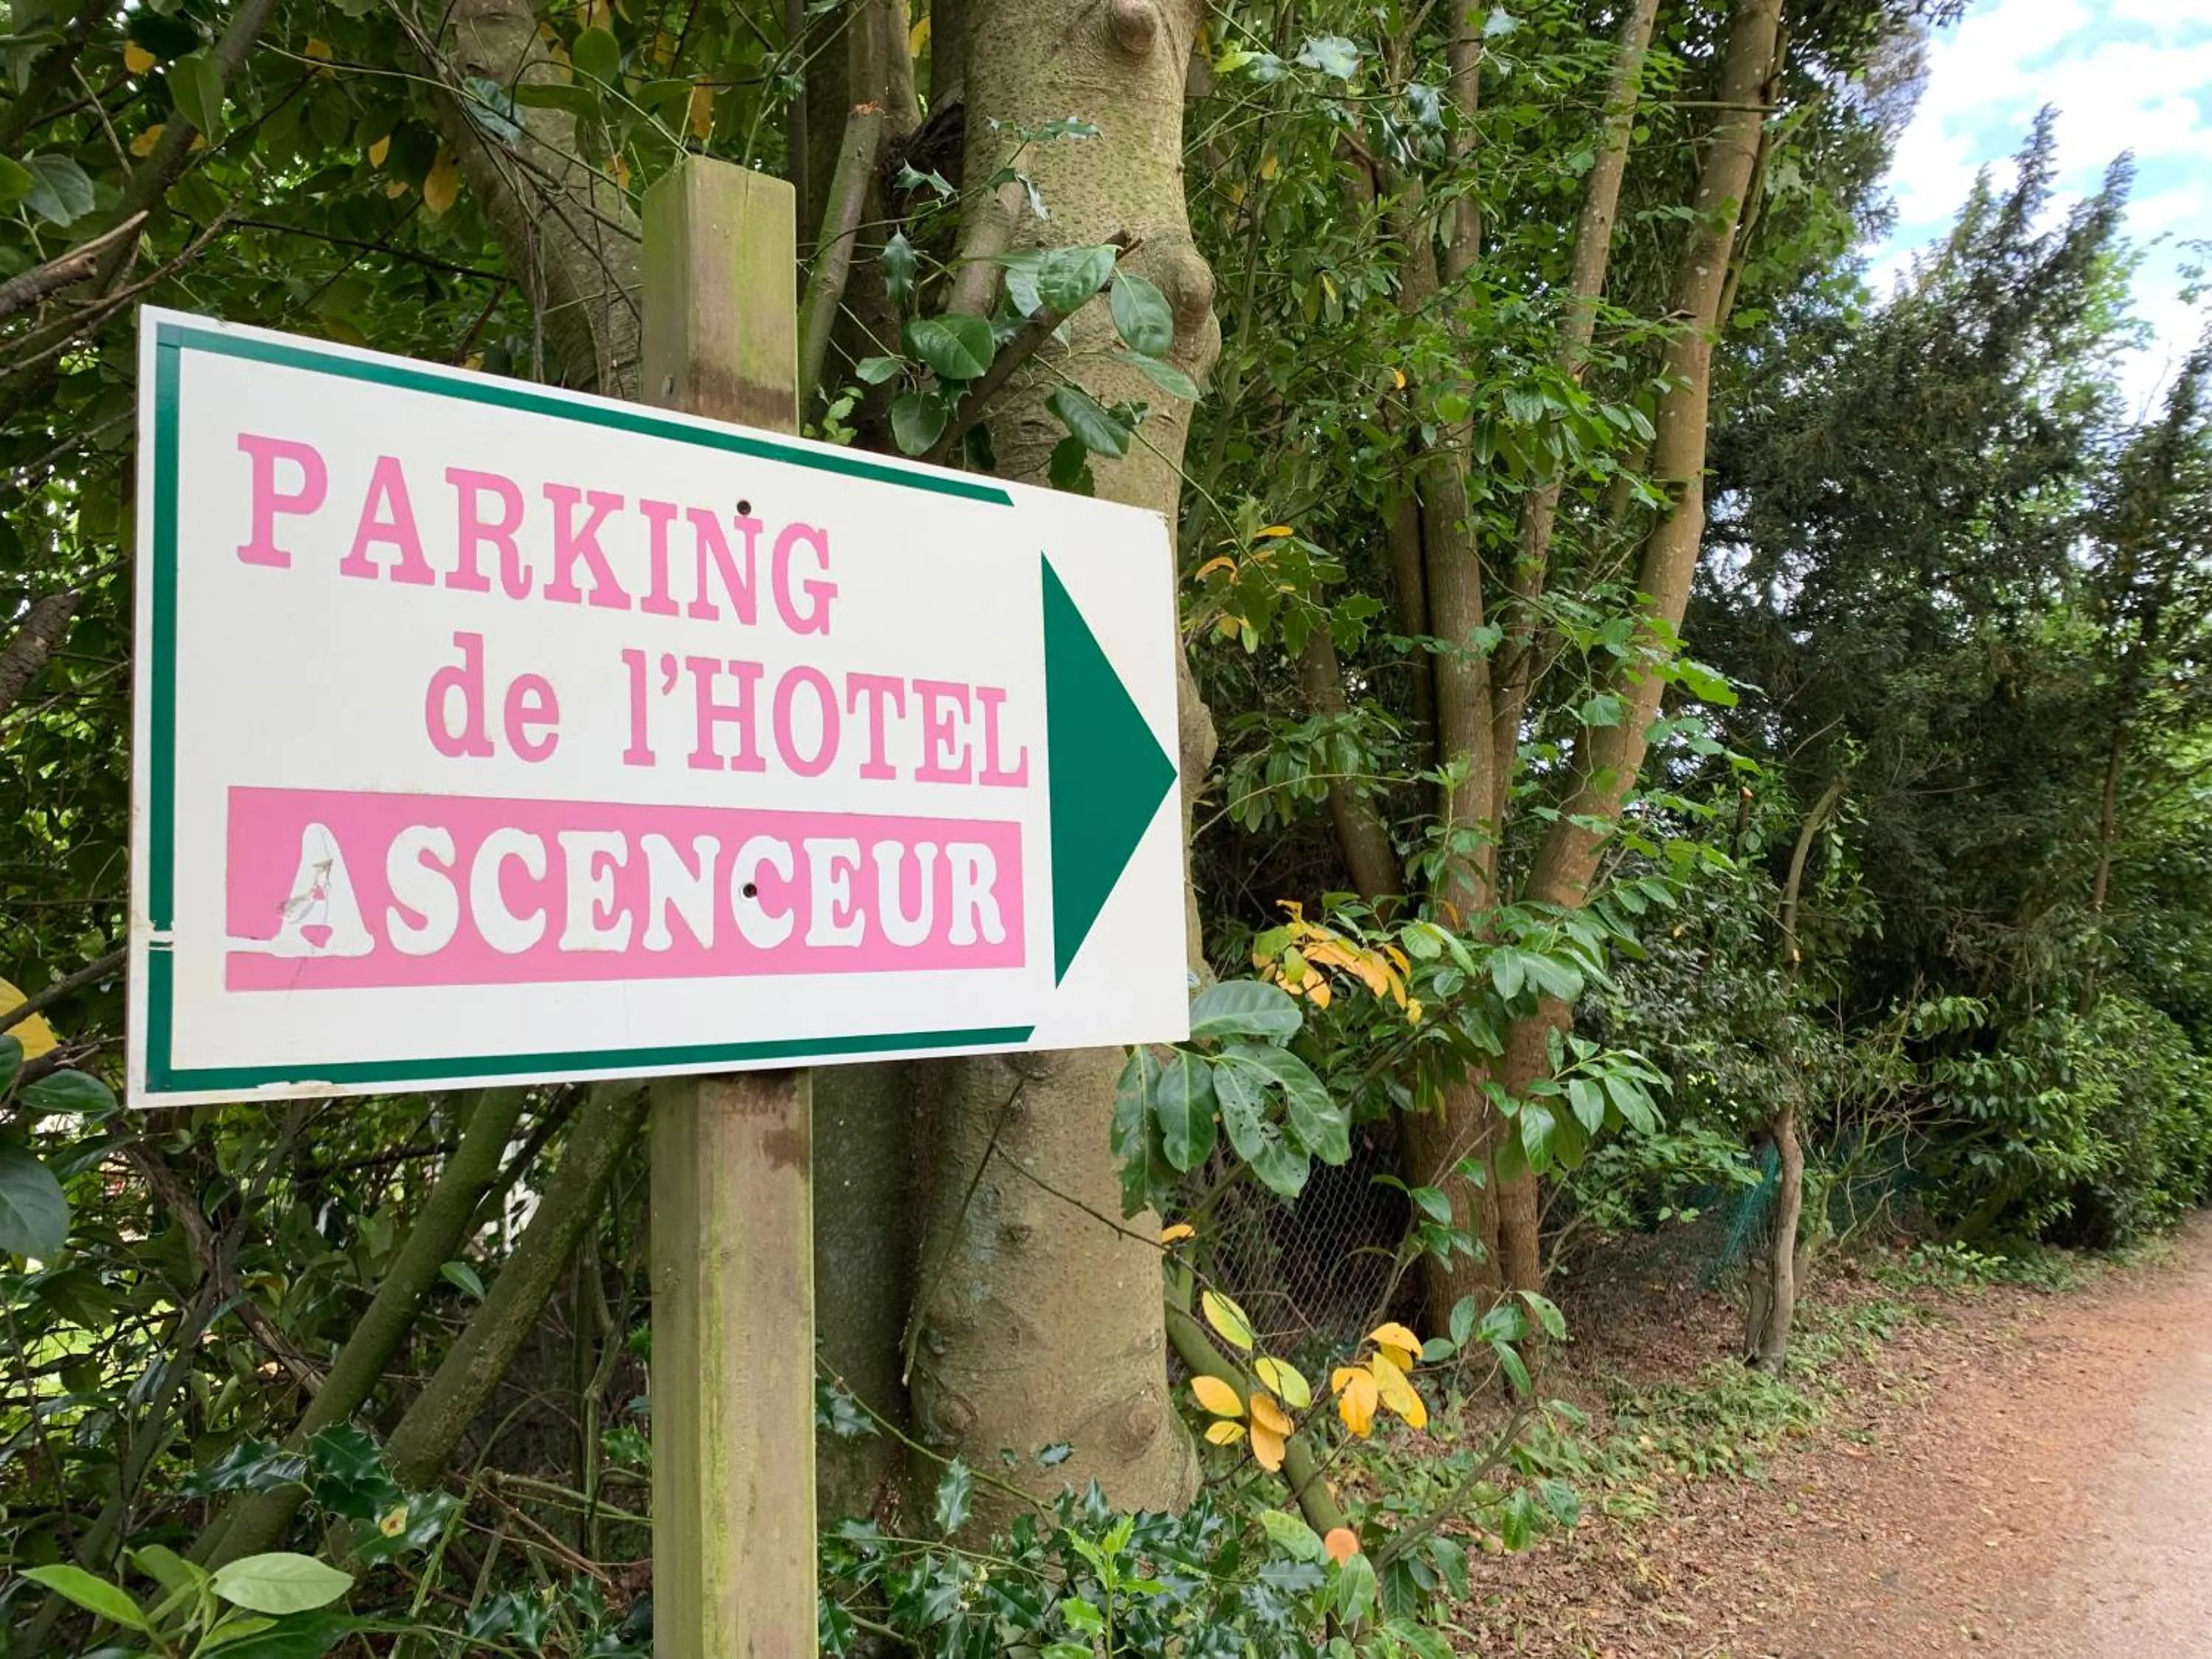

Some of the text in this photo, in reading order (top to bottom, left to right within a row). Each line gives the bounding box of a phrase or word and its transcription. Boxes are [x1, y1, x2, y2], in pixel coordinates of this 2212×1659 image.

[237, 433, 838, 636] PARKING
[425, 632, 1029, 787] de l'HOTEL
[273, 821, 1006, 958] ASCENCEUR
